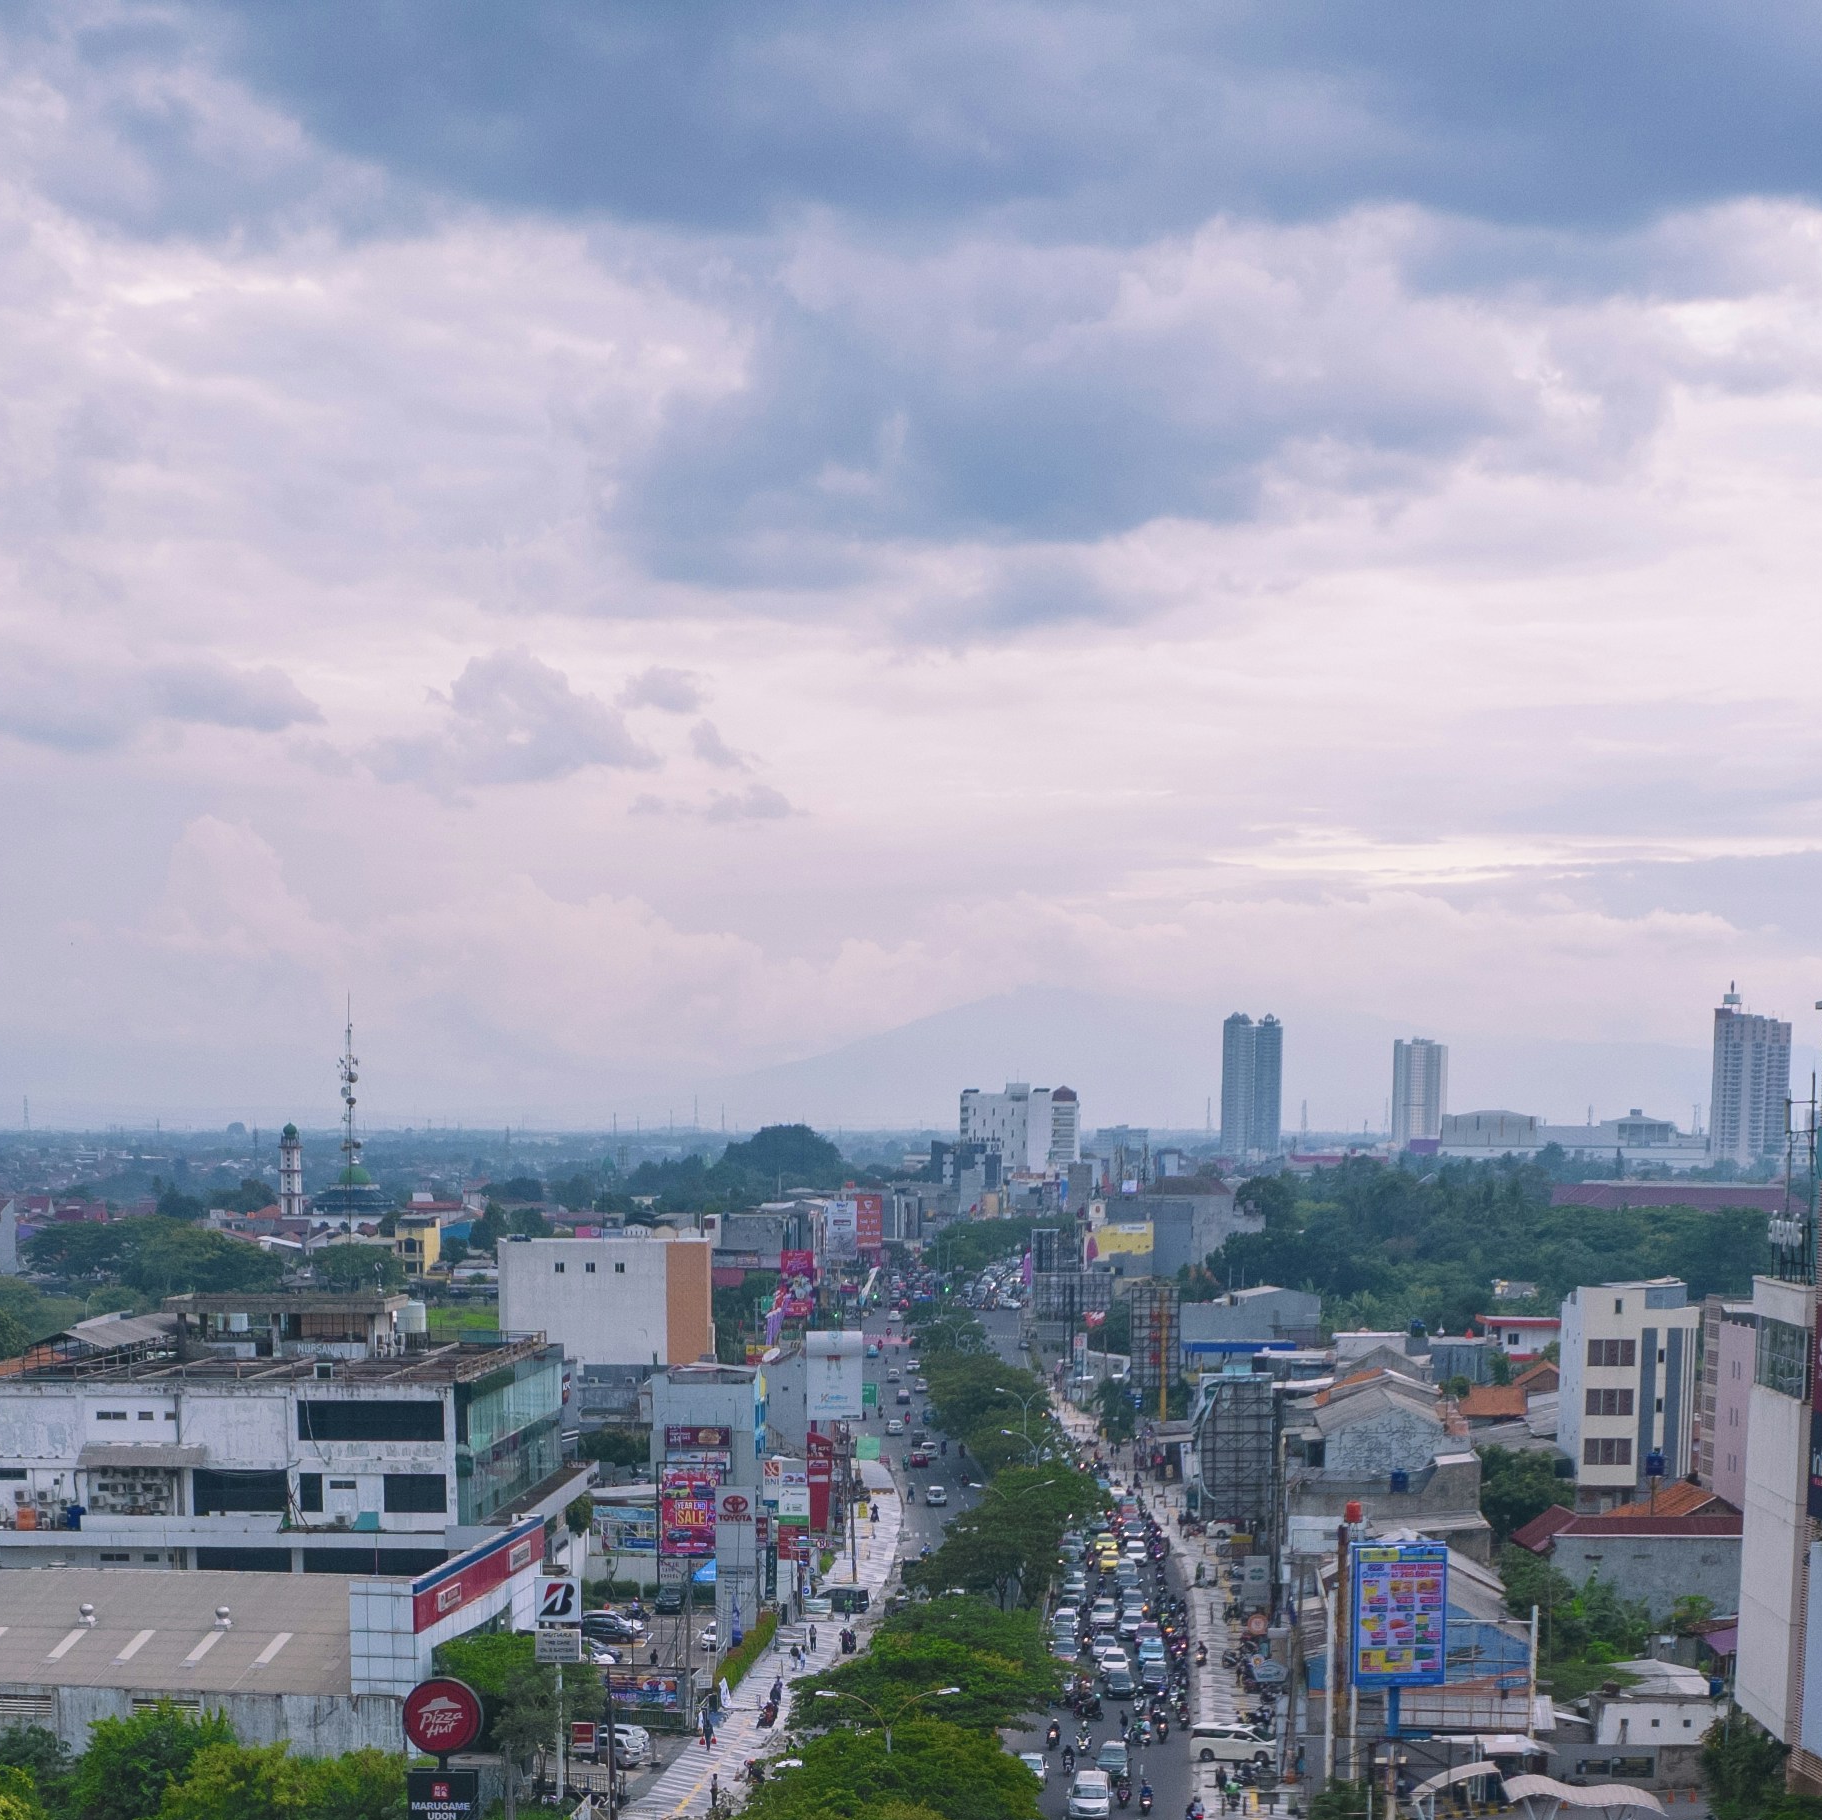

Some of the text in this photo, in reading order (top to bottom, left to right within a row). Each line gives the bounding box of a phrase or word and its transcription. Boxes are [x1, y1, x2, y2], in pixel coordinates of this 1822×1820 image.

[764, 1478, 779, 1487] BNI
[677, 1502, 692, 1510] YEAR
[678, 1510, 705, 1525] SALE
[718, 1514, 753, 1523] TOYOTA
[419, 1709, 464, 1731] Pizza
[426, 1721, 459, 1738] Hut
[411, 1801, 471, 1811] MARUGAME
[427, 1812, 456, 1820] UDON
